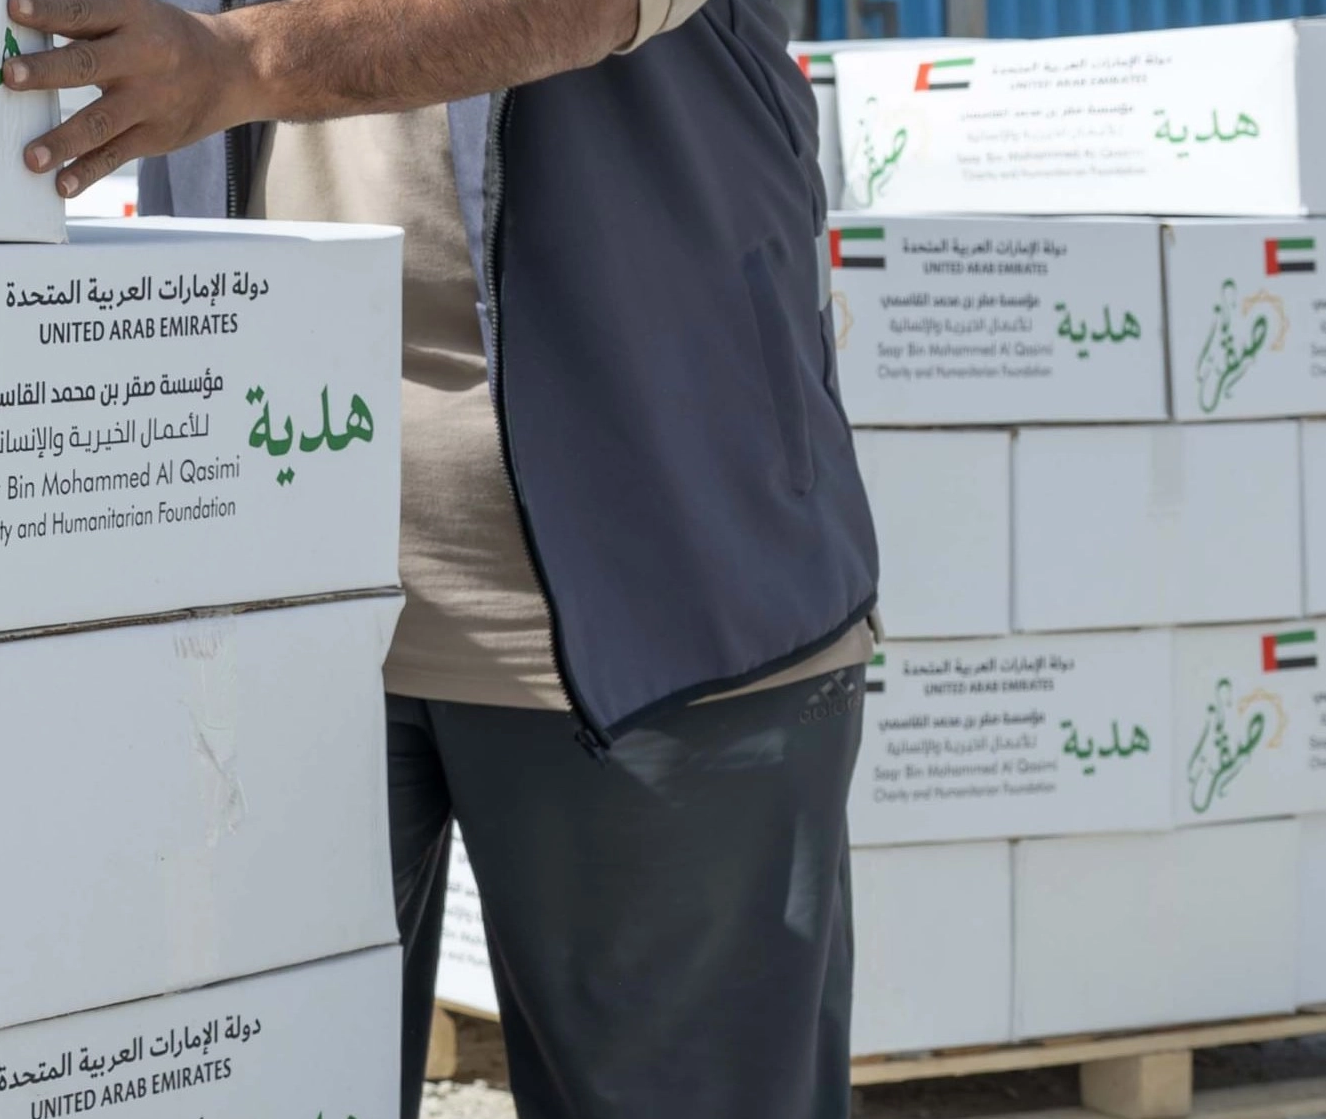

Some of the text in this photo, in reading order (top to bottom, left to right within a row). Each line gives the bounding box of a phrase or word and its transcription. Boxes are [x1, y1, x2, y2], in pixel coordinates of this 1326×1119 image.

[1153, 109, 1260, 159] هدية
[924, 262, 1048, 275] UNITED ARAB EMIRATES
[6, 271, 269, 310] دولة الإمارات العربية المتحدة
[39, 312, 238, 345] UNITED ARAB EMIRATES
[1055, 305, 1141, 361] هدية
[50, 384, 96, 403] محمد
[100, 383, 118, 407] بن
[122, 376, 156, 406] صقر
[159, 368, 223, 400] مؤسسة
[69, 419, 135, 454] الخيرية
[140, 413, 209, 448] للأعمال
[246, 387, 373, 483] هدية
[8, 475, 35, 500] Bin
[42, 462, 150, 497] Mohammed
[156, 460, 173, 485] Al
[180, 455, 240, 484] Qasimi
[17, 512, 47, 539] and
[53, 504, 152, 535] Humanitarian
[158, 497, 235, 523] Foundation
[924, 678, 1054, 696] UNITED ARAB EMIRATES
[1061, 720, 1150, 775] هدية
[150, 1020, 218, 1059] الإمارات
[224, 1015, 262, 1043] دولة
[79, 1036, 143, 1078] العربية
[30, 1057, 231, 1119] UNITED ARAB EMIRATES
